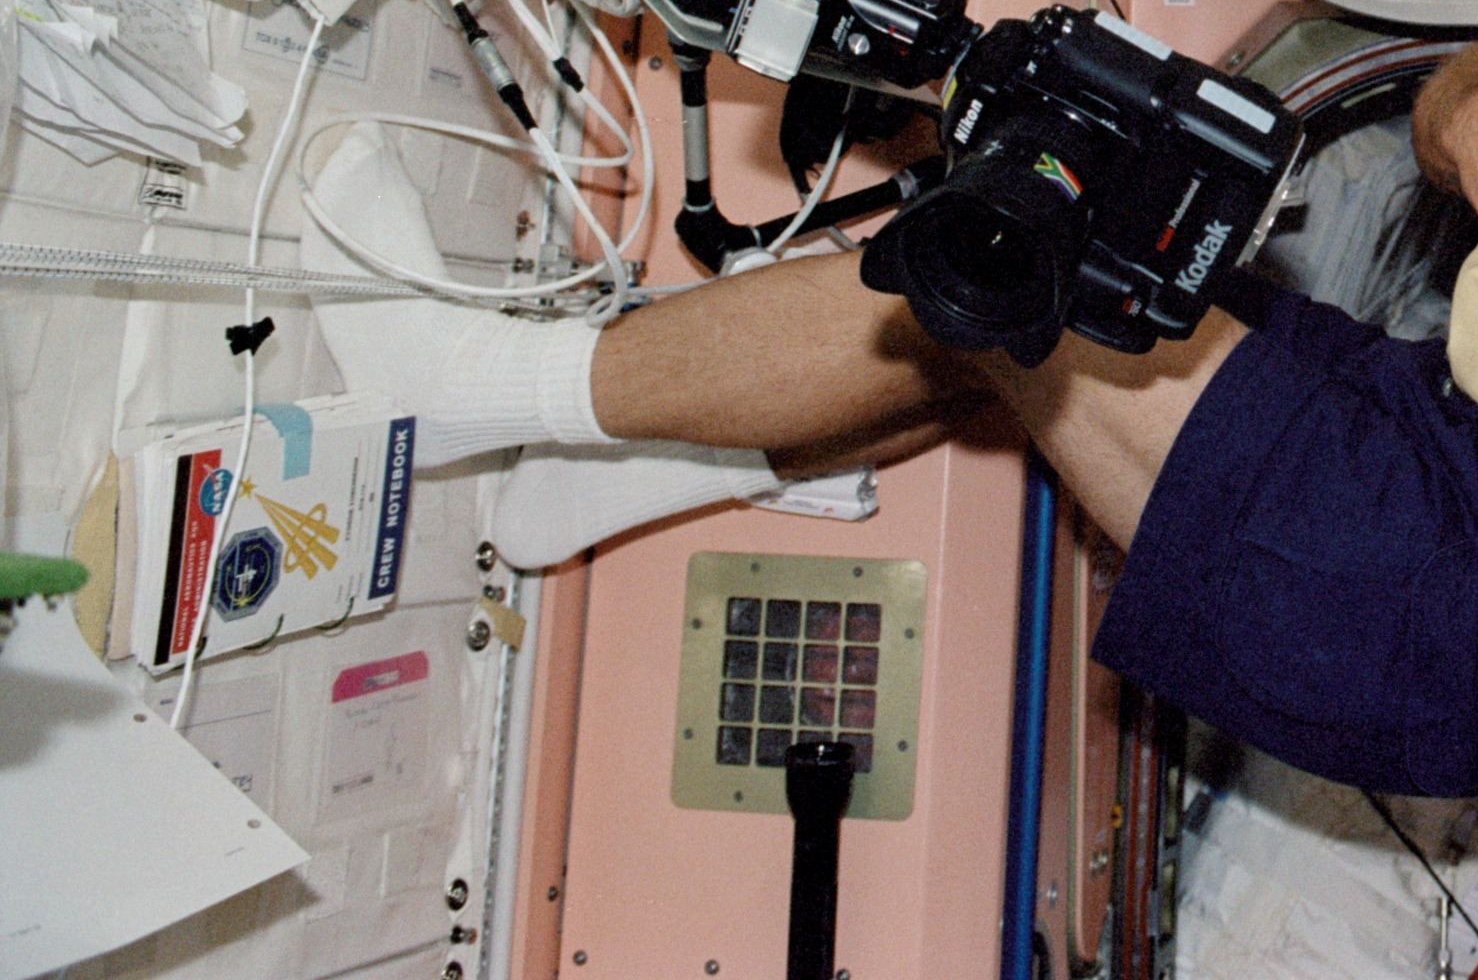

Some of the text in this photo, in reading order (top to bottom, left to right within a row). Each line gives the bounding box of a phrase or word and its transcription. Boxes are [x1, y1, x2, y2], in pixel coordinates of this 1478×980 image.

[953, 98, 984, 145] Nikon
[1174, 219, 1233, 294] Kodak
[212, 471, 225, 513] NASA
[376, 428, 409, 589] CREW NOTEBOOK
[177, 605, 189, 648] NATIONAL
